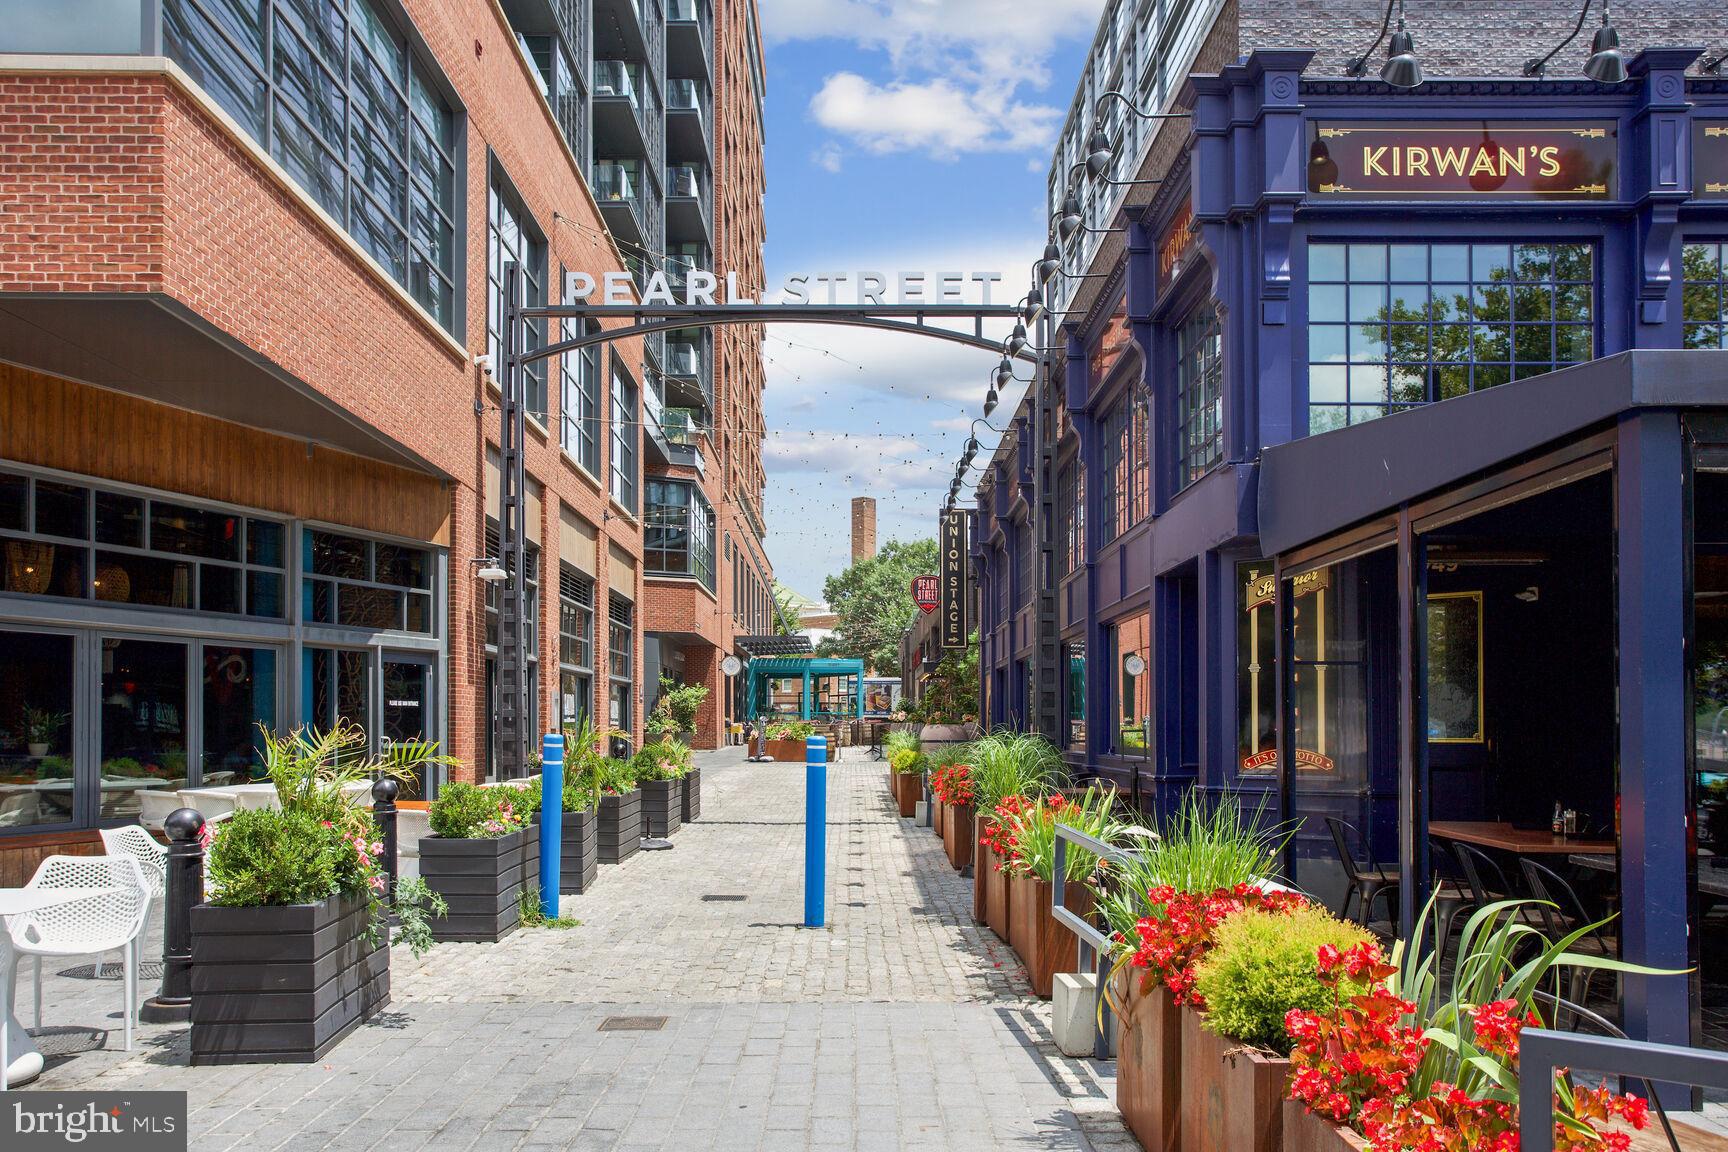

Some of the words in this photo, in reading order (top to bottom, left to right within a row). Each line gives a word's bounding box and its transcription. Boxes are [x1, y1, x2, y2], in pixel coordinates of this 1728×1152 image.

[1363, 146, 1561, 176] KIRWAN'S
[565, 271, 754, 306] PEARL
[782, 271, 1002, 305] STREET
[949, 514, 959, 572] UNION
[918, 590, 938, 600] STREET
[949, 576, 959, 633] STAGE
[1296, 751, 1322, 765] OTTO
